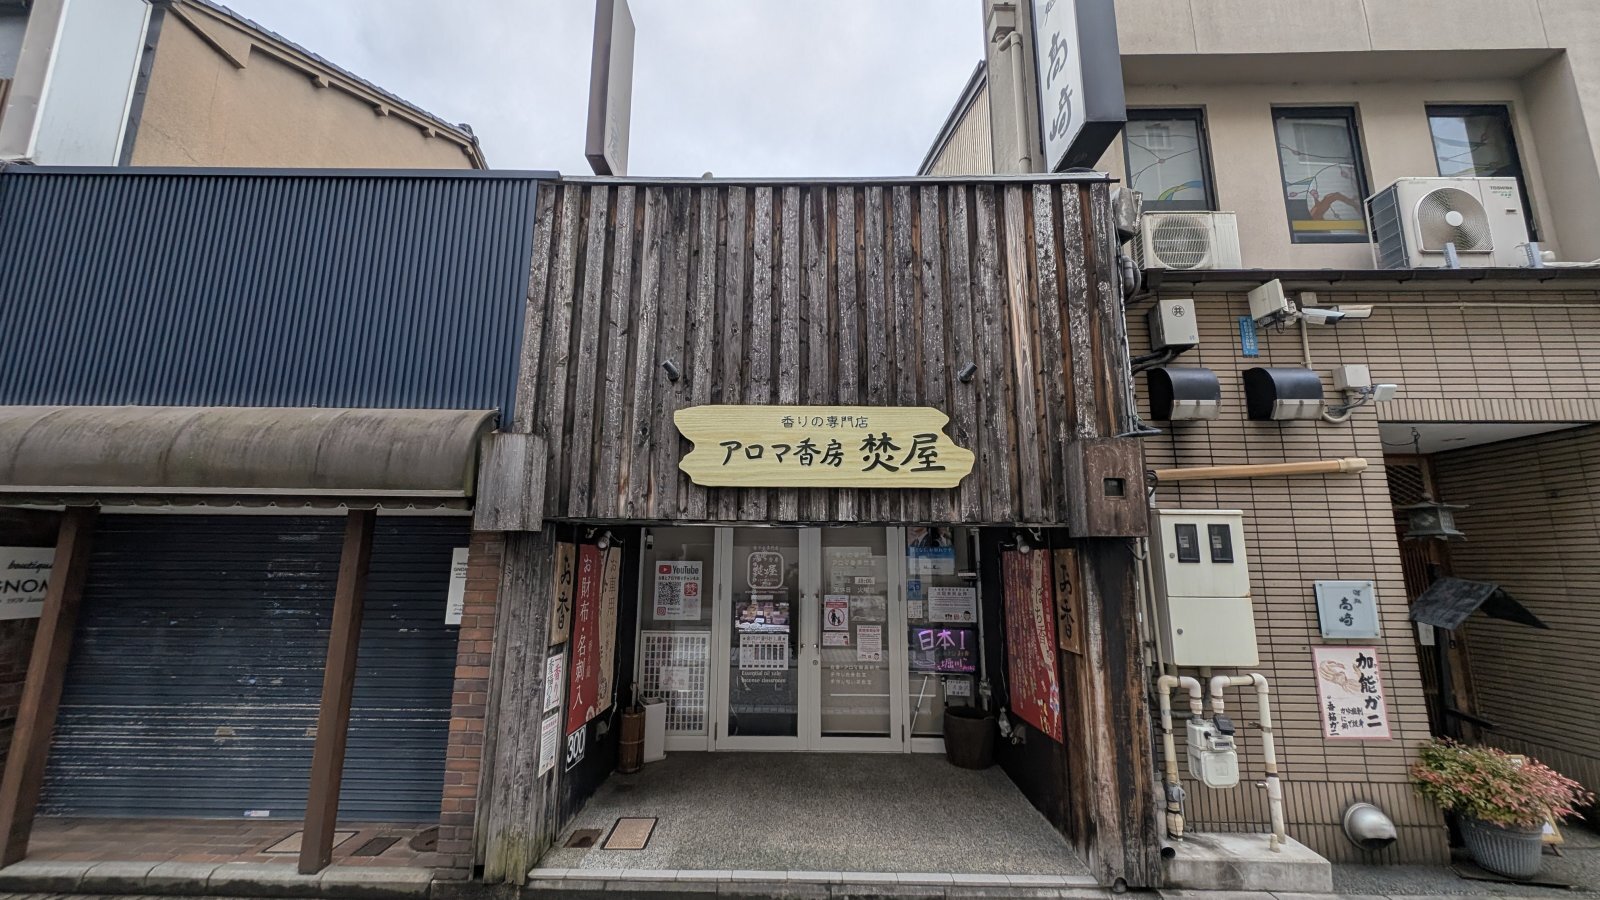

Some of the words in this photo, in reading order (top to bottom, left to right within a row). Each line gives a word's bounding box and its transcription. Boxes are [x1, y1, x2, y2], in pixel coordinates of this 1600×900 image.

[781, 415, 868, 429] 香りの専門店
[719, 437, 844, 468] アロマ香房
[859, 432, 946, 472] 焚屋
[673, 565, 699, 574] YouTube
[556, 555, 570, 630] お香
[1356, 652, 1382, 727] 加能ガニ
[567, 728, 586, 763] 300
